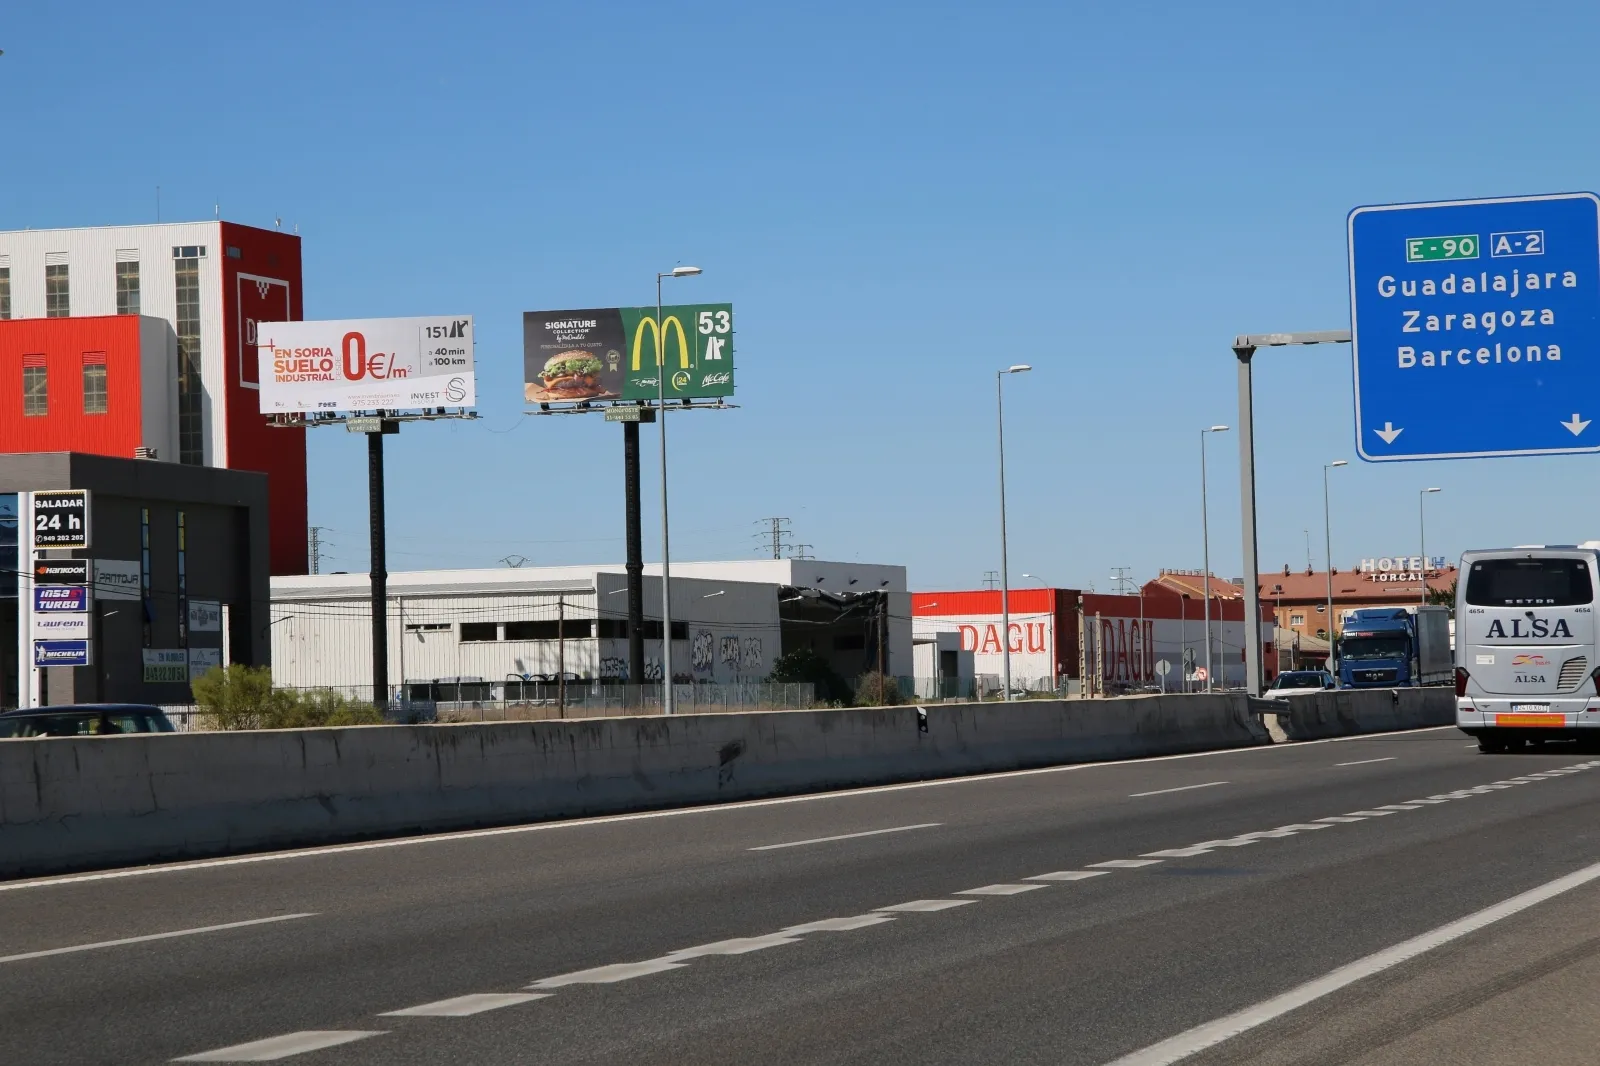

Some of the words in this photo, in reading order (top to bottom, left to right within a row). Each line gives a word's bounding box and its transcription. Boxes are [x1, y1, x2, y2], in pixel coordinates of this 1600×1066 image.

[1494, 234, 1541, 254] A-2
[1378, 269, 1577, 298] Guadalajara
[545, 320, 597, 330] SIGNATURE
[698, 310, 730, 334] 53
[1402, 308, 1555, 336] Zaragoza
[426, 326, 447, 338] 151
[274, 348, 292, 359] EN
[294, 347, 334, 358] SORIA
[434, 347, 448, 356] 40
[448, 347, 466, 356] min
[1398, 343, 1562, 368] Barcelona
[273, 358, 334, 374] SUELO
[433, 357, 450, 366] 100
[451, 357, 466, 366] km
[275, 372, 335, 383] INDUSTRIAL
[410, 391, 440, 400] INVEST
[35, 499, 83, 508] SALADAR
[36, 514, 61, 531] 24
[68, 514, 81, 530] h
[1361, 556, 1435, 572] HOTEL
[1371, 572, 1425, 583] TORCAL
[39, 601, 80, 609] TURBO
[1485, 618, 1574, 638] ALSA
[956, 622, 1046, 656] DAGU
[46, 650, 85, 658] MICHELIN
[1101, 618, 1155, 681] DAGU
[1514, 675, 1546, 683] ALSA
